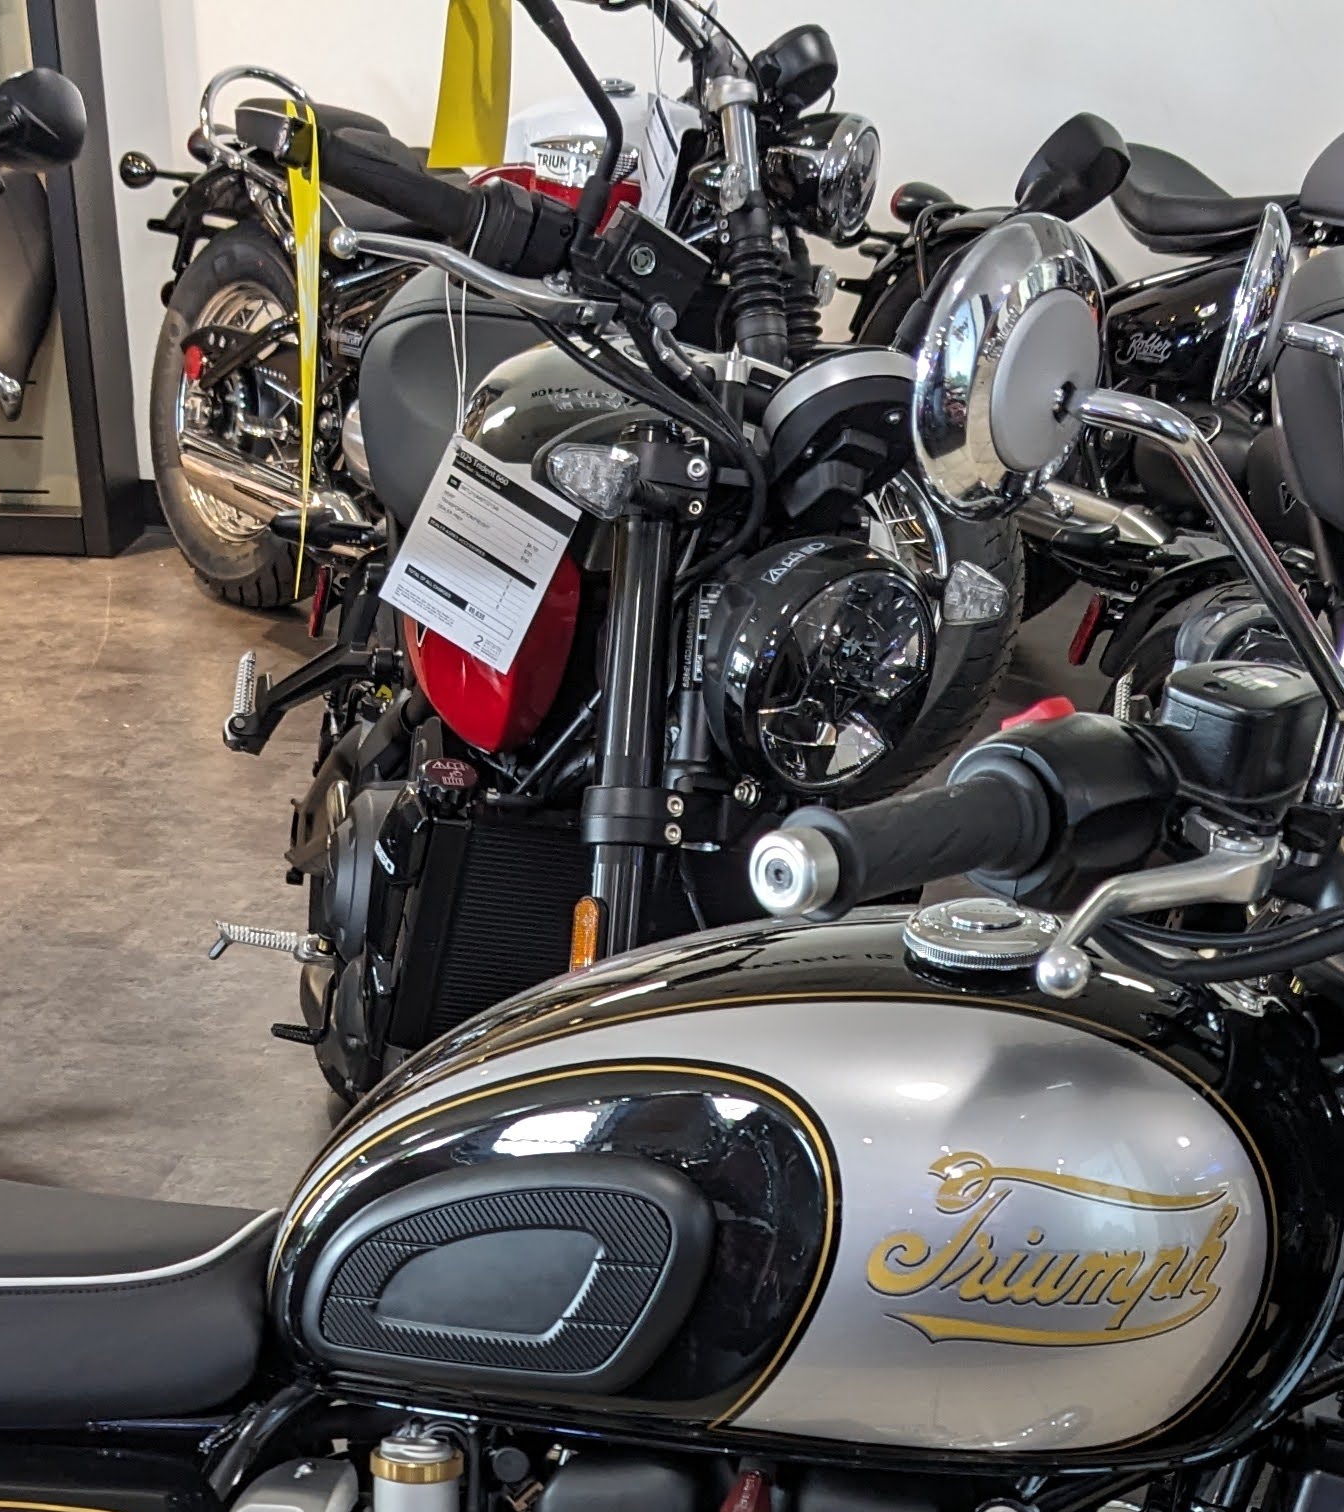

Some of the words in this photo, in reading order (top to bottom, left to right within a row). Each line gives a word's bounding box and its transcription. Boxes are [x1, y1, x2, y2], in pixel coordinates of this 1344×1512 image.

[1115, 332, 1172, 364] Bobber
[472, 459, 496, 479] Trident
[496, 473, 508, 487] 660
[867, 1152, 1239, 1347] Triumph
